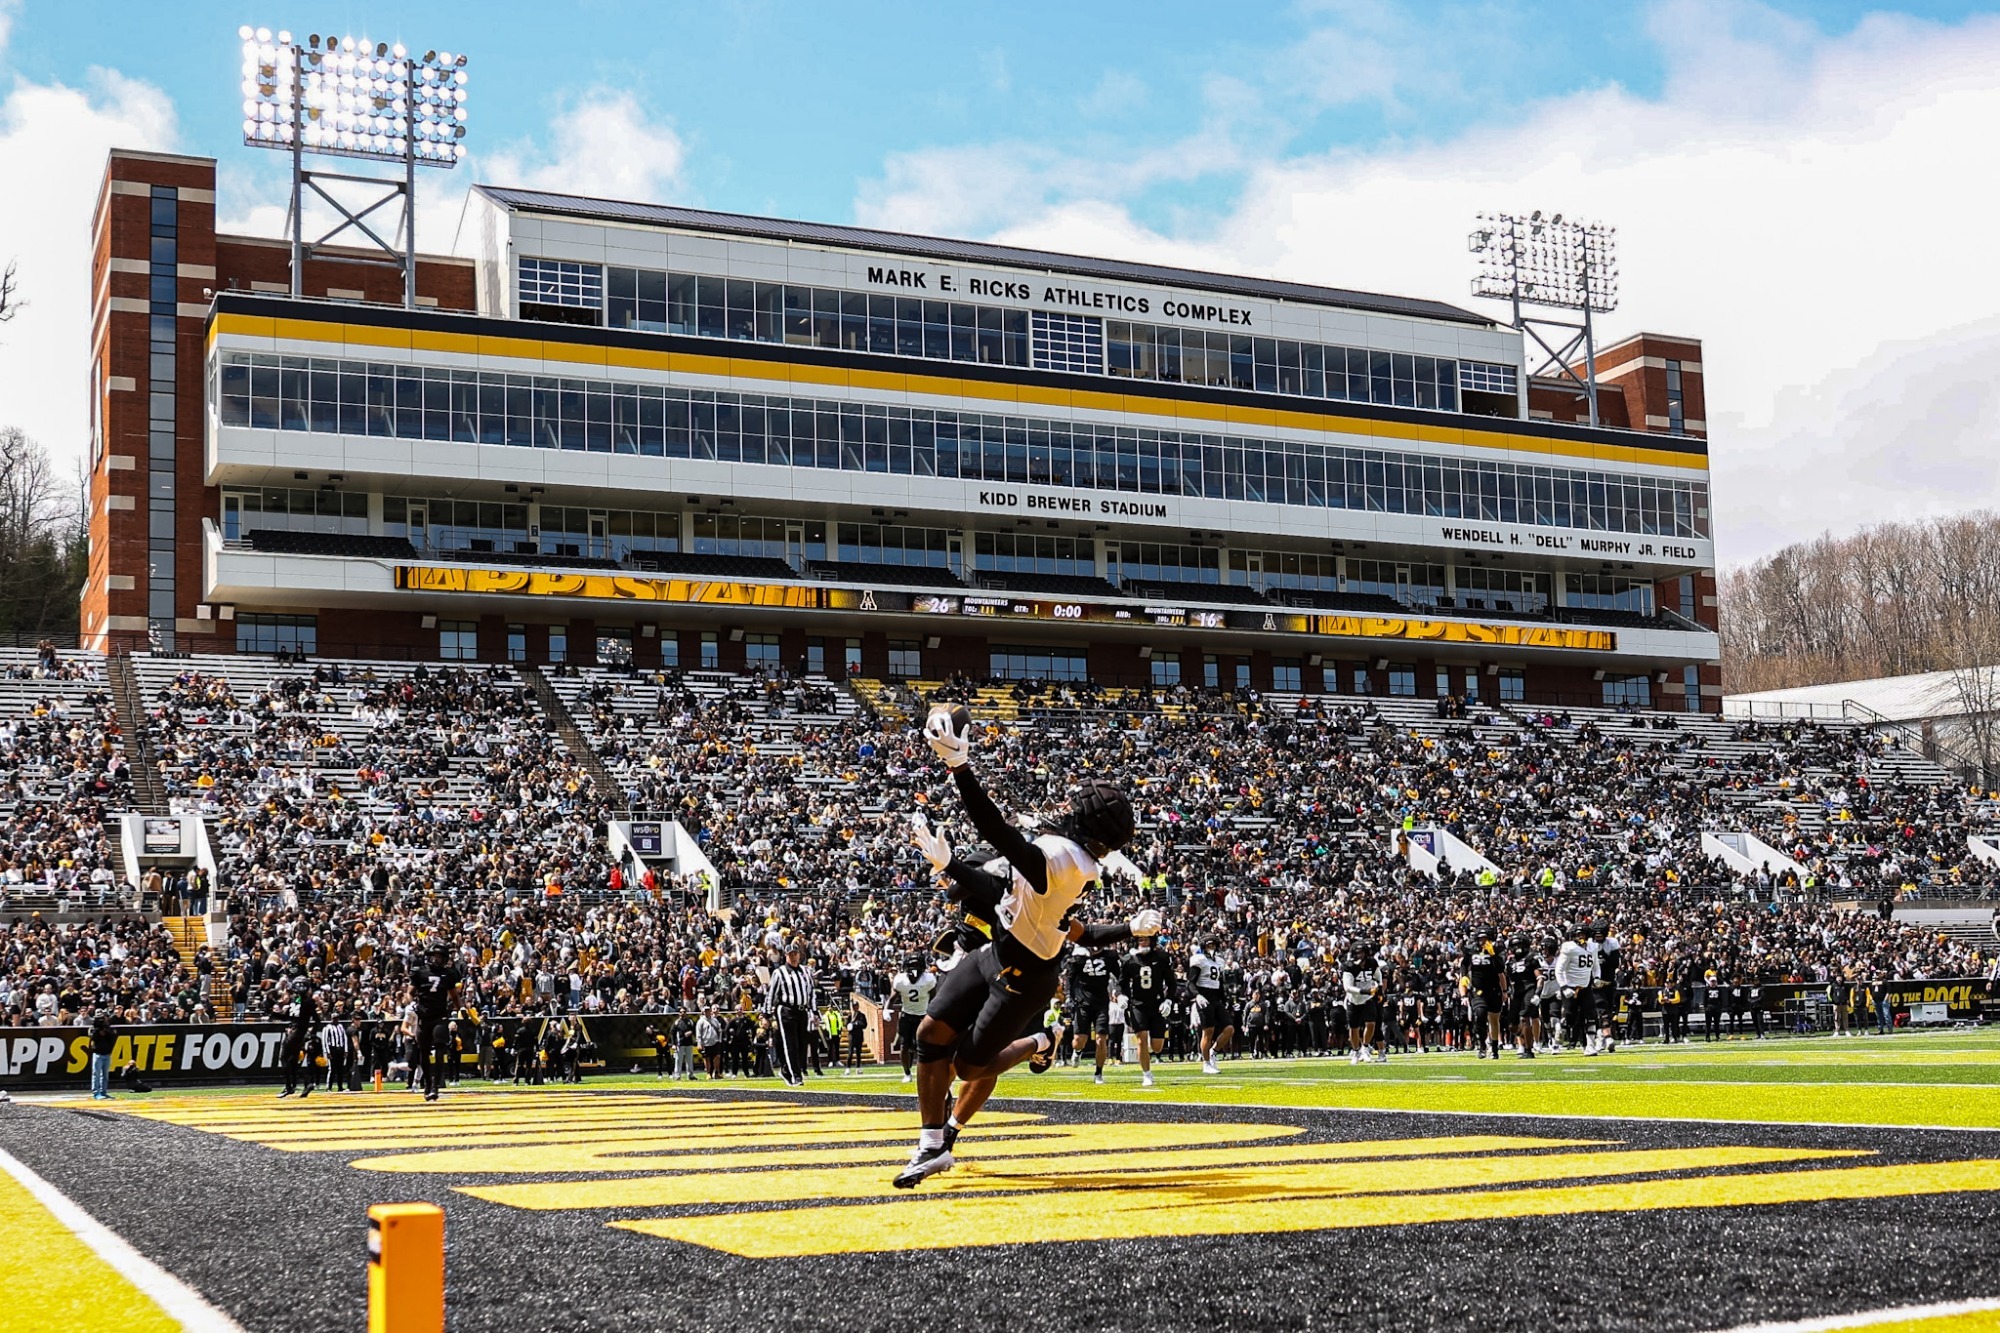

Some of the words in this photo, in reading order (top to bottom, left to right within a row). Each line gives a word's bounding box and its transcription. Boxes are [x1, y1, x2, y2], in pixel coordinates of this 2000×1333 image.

[867, 266, 927, 289] MARK
[940, 275, 957, 292] E.
[969, 278, 1031, 300] RICKS
[1043, 287, 1150, 314] ATHLETICS
[1163, 301, 1253, 326] COMPLEX
[979, 491, 1018, 507] KIDD
[1027, 496, 1091, 512] BREWER
[1100, 501, 1167, 518] STADIUM
[1441, 527, 1504, 545] WENDELL
[1510, 533, 1523, 546] H.
[1528, 533, 1573, 549] "DELL"
[1580, 539, 1631, 554] MURPHY
[1638, 544, 1656, 556] JR.
[1662, 546, 1696, 559] FIELD
[929, 597, 950, 614] 26
[1053, 604, 1082, 619] 0:00
[1199, 612, 1217, 628] 16
[1083, 959, 1107, 976] 42
[1578, 954, 1593, 968] 66
[428, 975, 441, 993] 7
[1139, 966, 1152, 989] 8
[908, 989, 919, 1003] 2
[66, 1034, 176, 1074] SATE
[181, 1032, 286, 1070] FOOT
